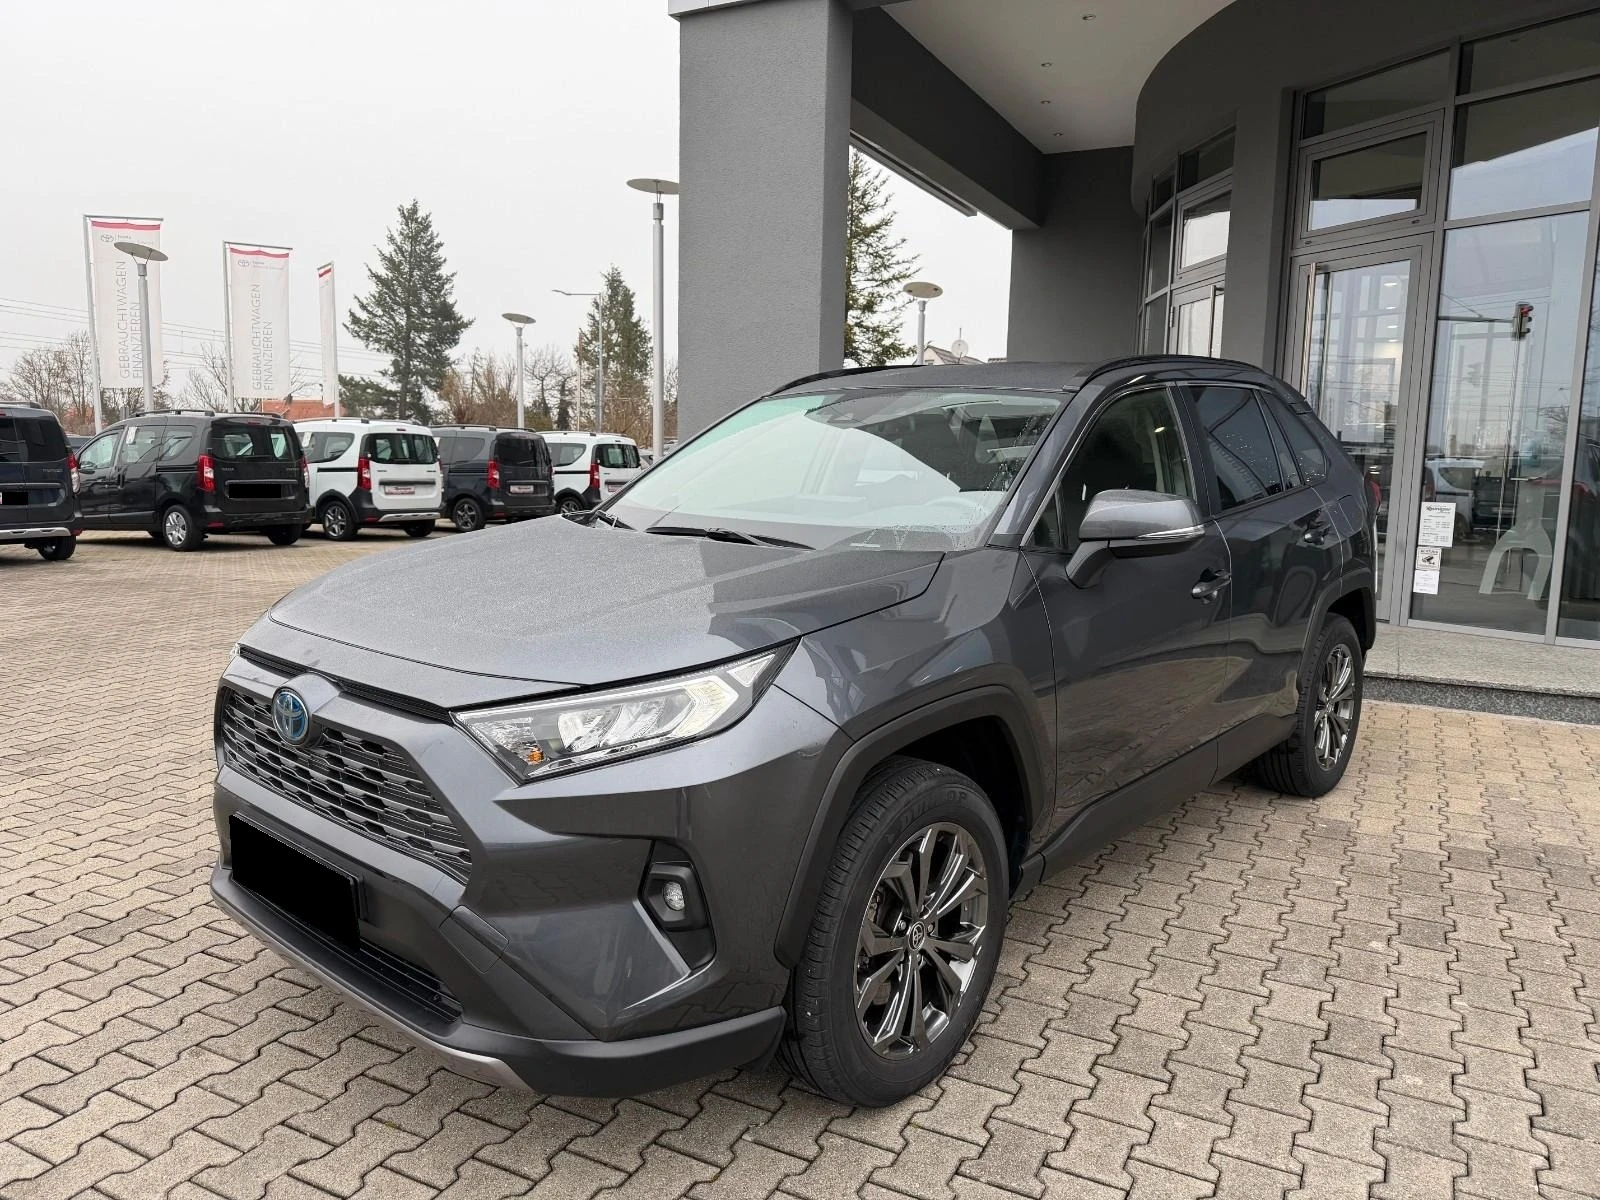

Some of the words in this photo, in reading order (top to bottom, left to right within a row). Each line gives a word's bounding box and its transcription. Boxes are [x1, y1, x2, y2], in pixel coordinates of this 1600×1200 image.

[115, 261, 131, 379] GEBRAUCHTWAGEN
[250, 284, 262, 391] GEBRAUCHTWAGEN
[263, 320, 274, 391] FINANZIEREN
